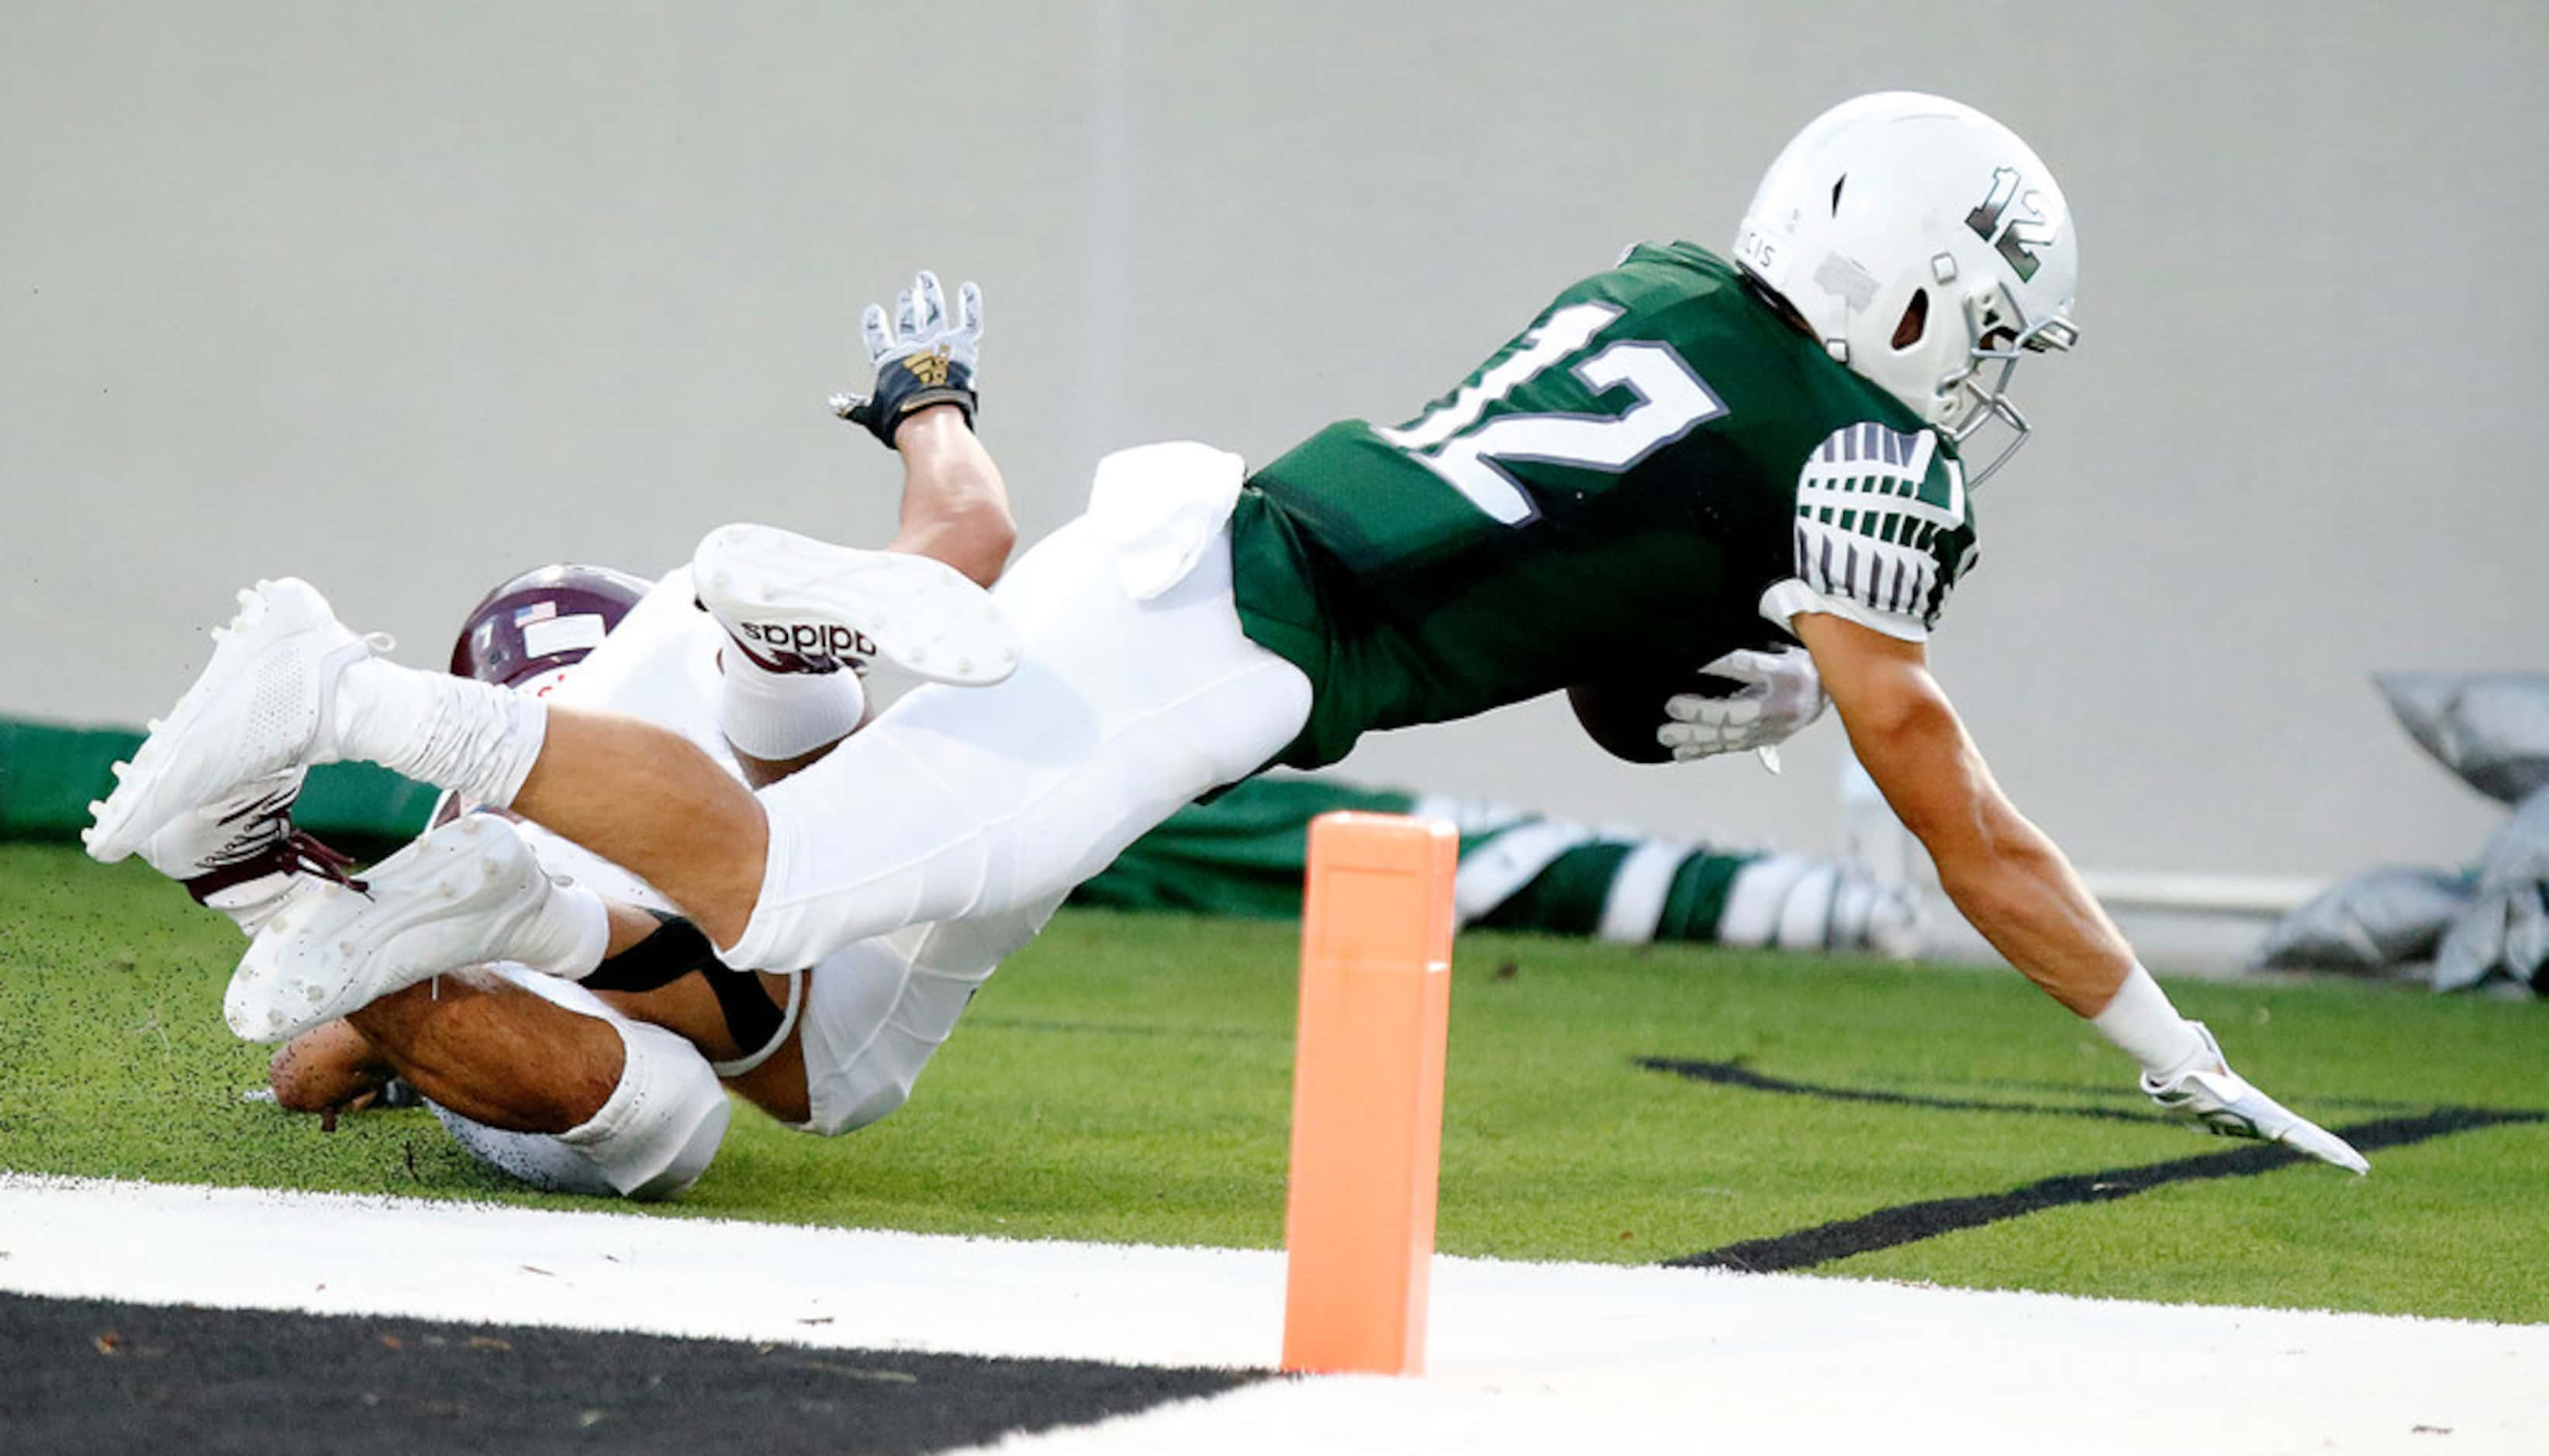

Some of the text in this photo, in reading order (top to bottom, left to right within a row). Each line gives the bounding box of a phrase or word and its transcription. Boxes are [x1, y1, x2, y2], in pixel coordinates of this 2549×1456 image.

[1964, 166, 2057, 284] 12
[1369, 299, 1730, 529] 12
[741, 623, 876, 657] adidas
